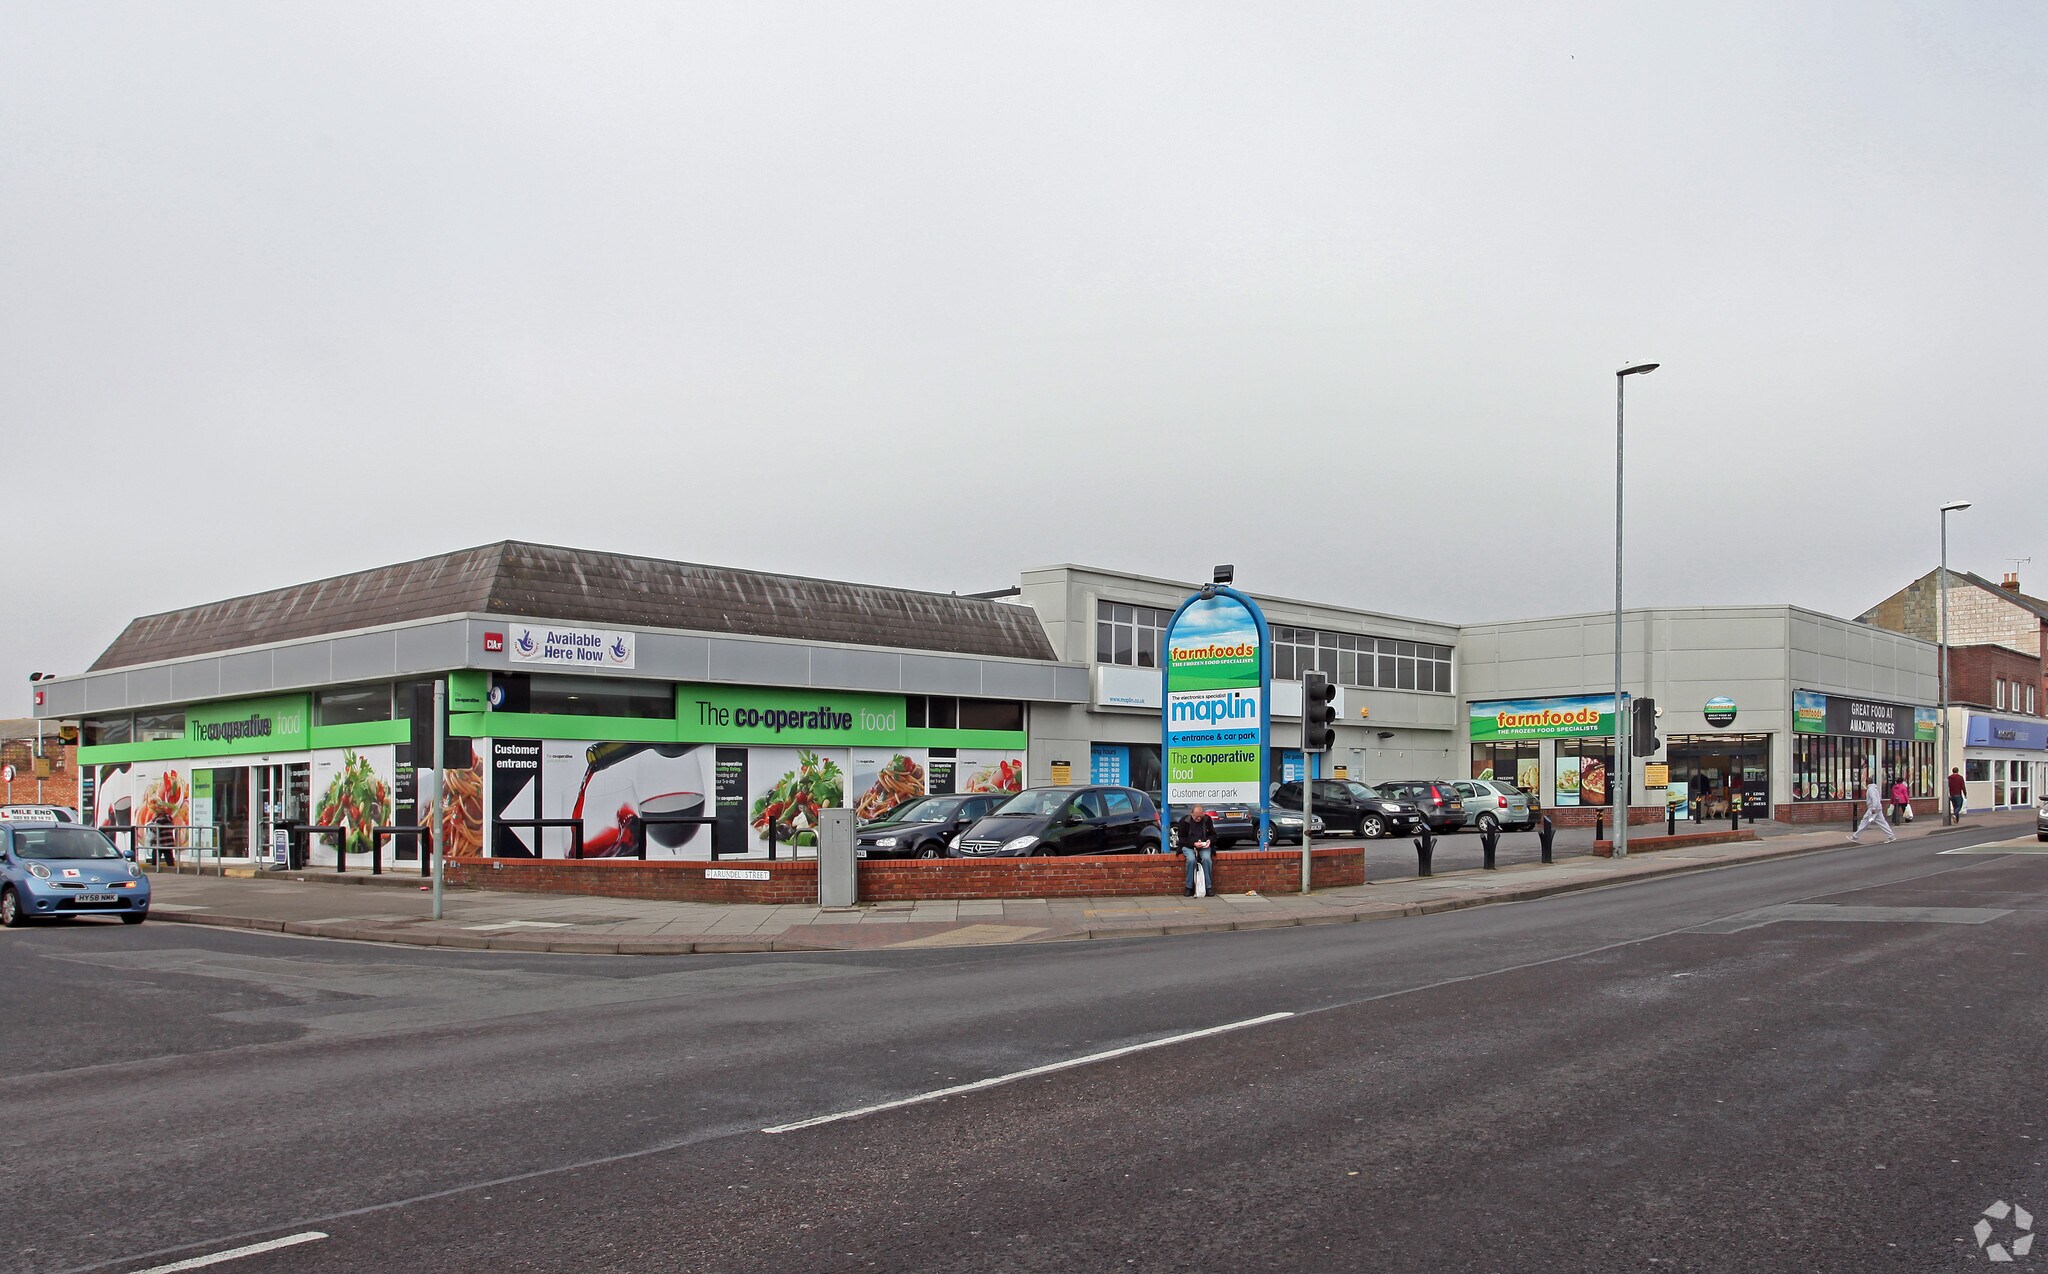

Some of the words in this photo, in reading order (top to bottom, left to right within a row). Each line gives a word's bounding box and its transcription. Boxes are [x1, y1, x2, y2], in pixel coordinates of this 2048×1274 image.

[546, 631, 602, 648] Available
[544, 646, 572, 660] Here
[576, 648, 604, 662] Now
[1172, 643, 1254, 660] farmfoods
[696, 701, 729, 726] The
[734, 706, 852, 732] co-operative
[860, 708, 896, 732] food
[1172, 692, 1256, 725] maplin
[1799, 706, 1822, 719] farmfoods
[1852, 702, 1870, 716] GREAT
[1871, 706, 1885, 717] FOOD
[1886, 707, 1893, 718] AT
[1498, 708, 1600, 728] farmfoods
[192, 720, 208, 741] The
[208, 714, 272, 744] co-operative
[278, 711, 300, 735] food
[1850, 719, 1874, 732] AMAZING
[1876, 722, 1894, 734] PRICES
[1182, 734, 1214, 742] entrance
[1238, 732, 1256, 741] park
[494, 744, 539, 755] Customer
[496, 759, 537, 768] entrance
[1172, 752, 1188, 764] The
[1190, 750, 1254, 766] co-operative
[1172, 767, 1194, 780] food
[1172, 788, 1206, 798] Customer
[1208, 789, 1220, 798] car
[1222, 788, 1238, 799] park
